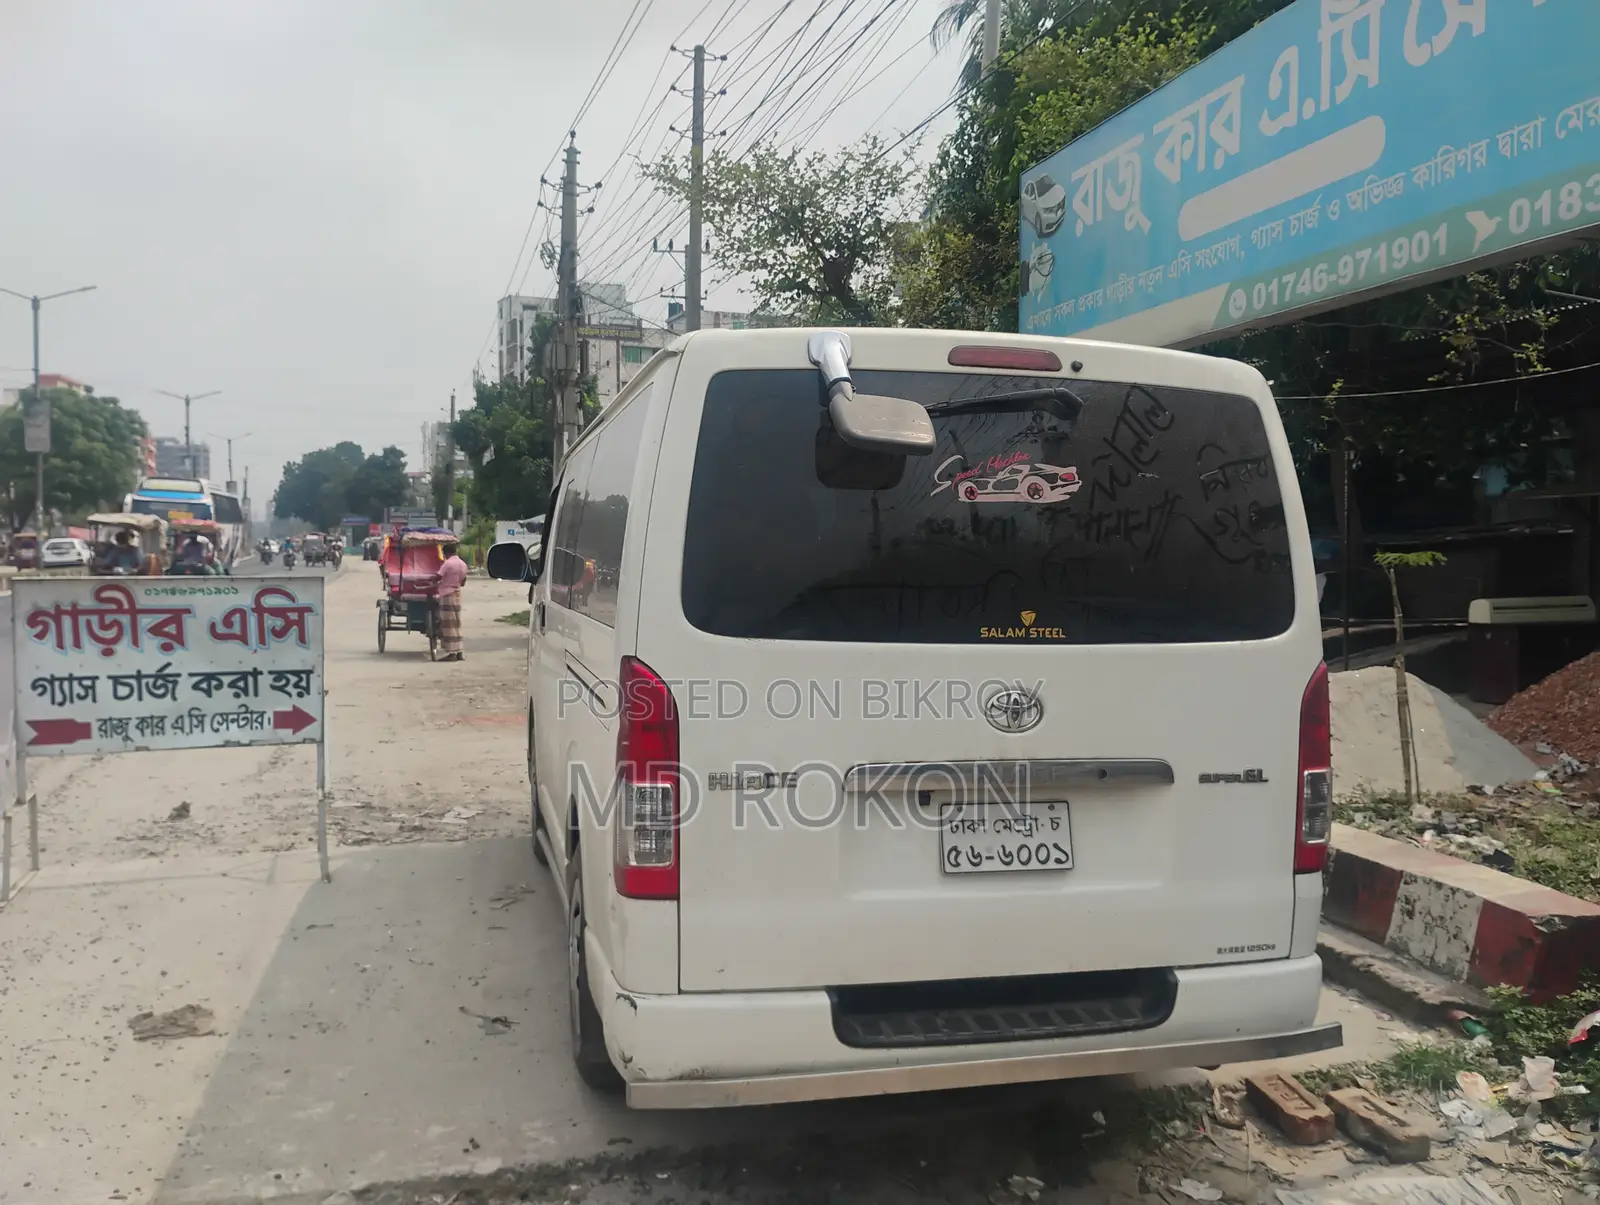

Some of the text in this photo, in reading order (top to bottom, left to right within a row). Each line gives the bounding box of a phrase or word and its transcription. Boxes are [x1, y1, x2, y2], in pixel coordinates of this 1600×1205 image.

[1070, 132, 1151, 238] রাজু
[1153, 73, 1246, 184] কার
[1138, 264, 1167, 294] নতুন
[1167, 249, 1194, 281] এসি
[1250, 218, 1286, 250] গ্যাস
[1327, 199, 1341, 221] ও
[1409, 139, 1492, 193] কারিগর
[1495, 113, 1548, 161] দ্বারা
[1251, 222, 1449, 311] 01746-971901
[26, 583, 315, 657] গাড়ীর এসি
[980, 627, 1067, 639] SALAM STEEL
[30, 661, 314, 707] গ্যাস চার্জ করা হয়
[96, 715, 136, 743] রাজু
[134, 714, 167, 738] কার
[948, 817, 986, 835] ঢাকা
[946, 842, 1070, 868] ৫৬-৬০০১
